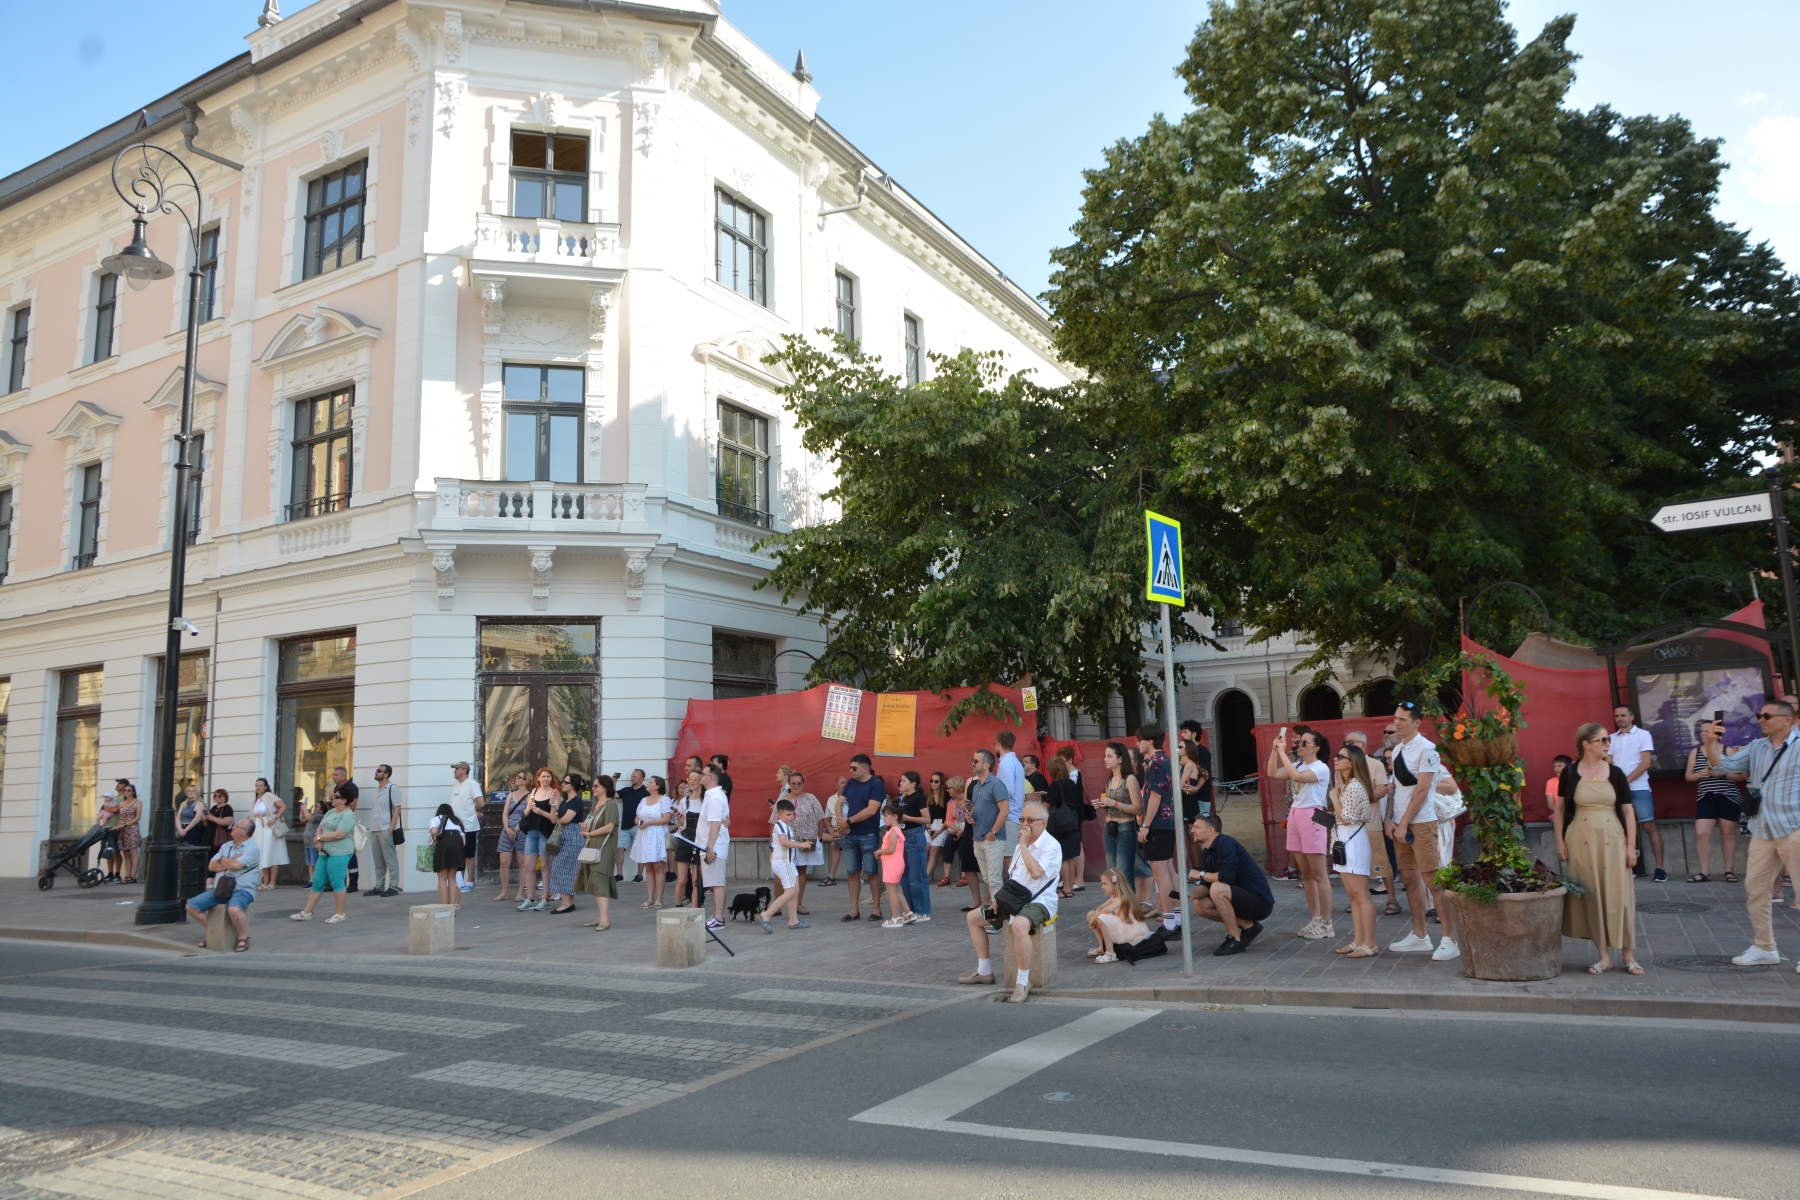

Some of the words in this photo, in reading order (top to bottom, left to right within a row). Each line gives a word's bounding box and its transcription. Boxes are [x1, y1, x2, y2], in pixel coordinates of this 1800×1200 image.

[1662, 515, 1679, 524] str.
[1682, 510, 1711, 521] IOSIF
[1713, 504, 1762, 517] VULCAN
